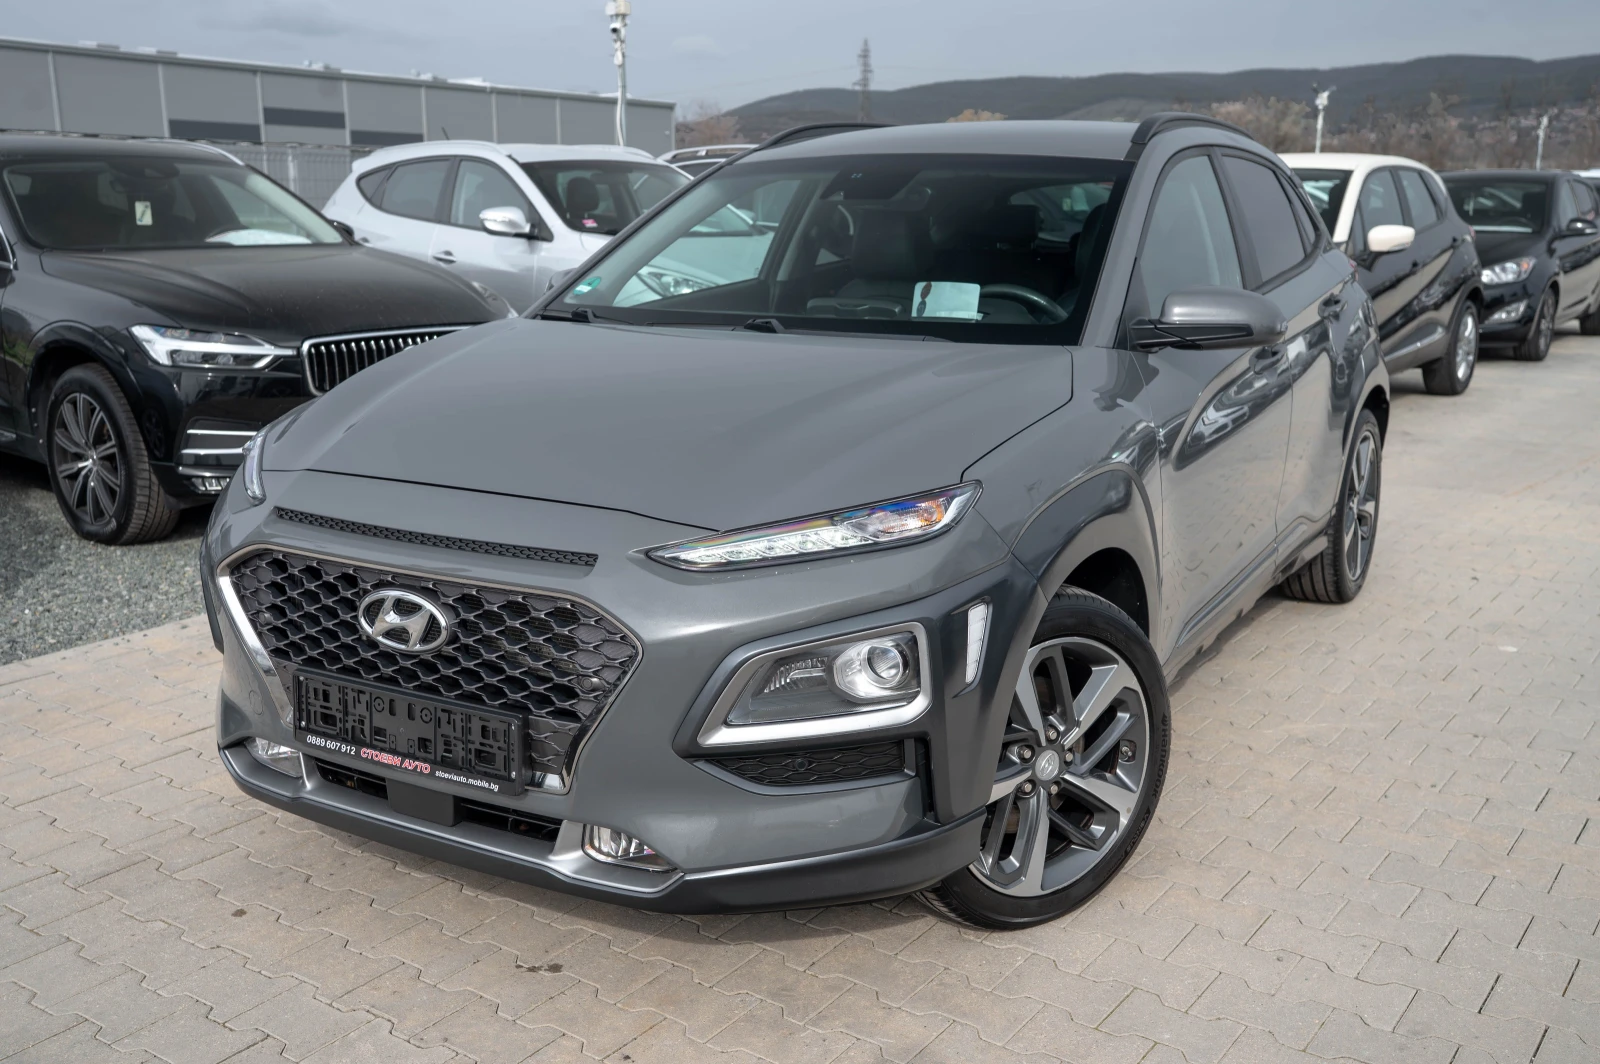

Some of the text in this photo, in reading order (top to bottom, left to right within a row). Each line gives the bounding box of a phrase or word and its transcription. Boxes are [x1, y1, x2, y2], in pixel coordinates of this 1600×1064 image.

[306, 735, 356, 755] 0889 607 912
[360, 747, 431, 774] СТОЕВИ АУТО
[435, 770, 499, 792] stoeviauto.mobile.bg
